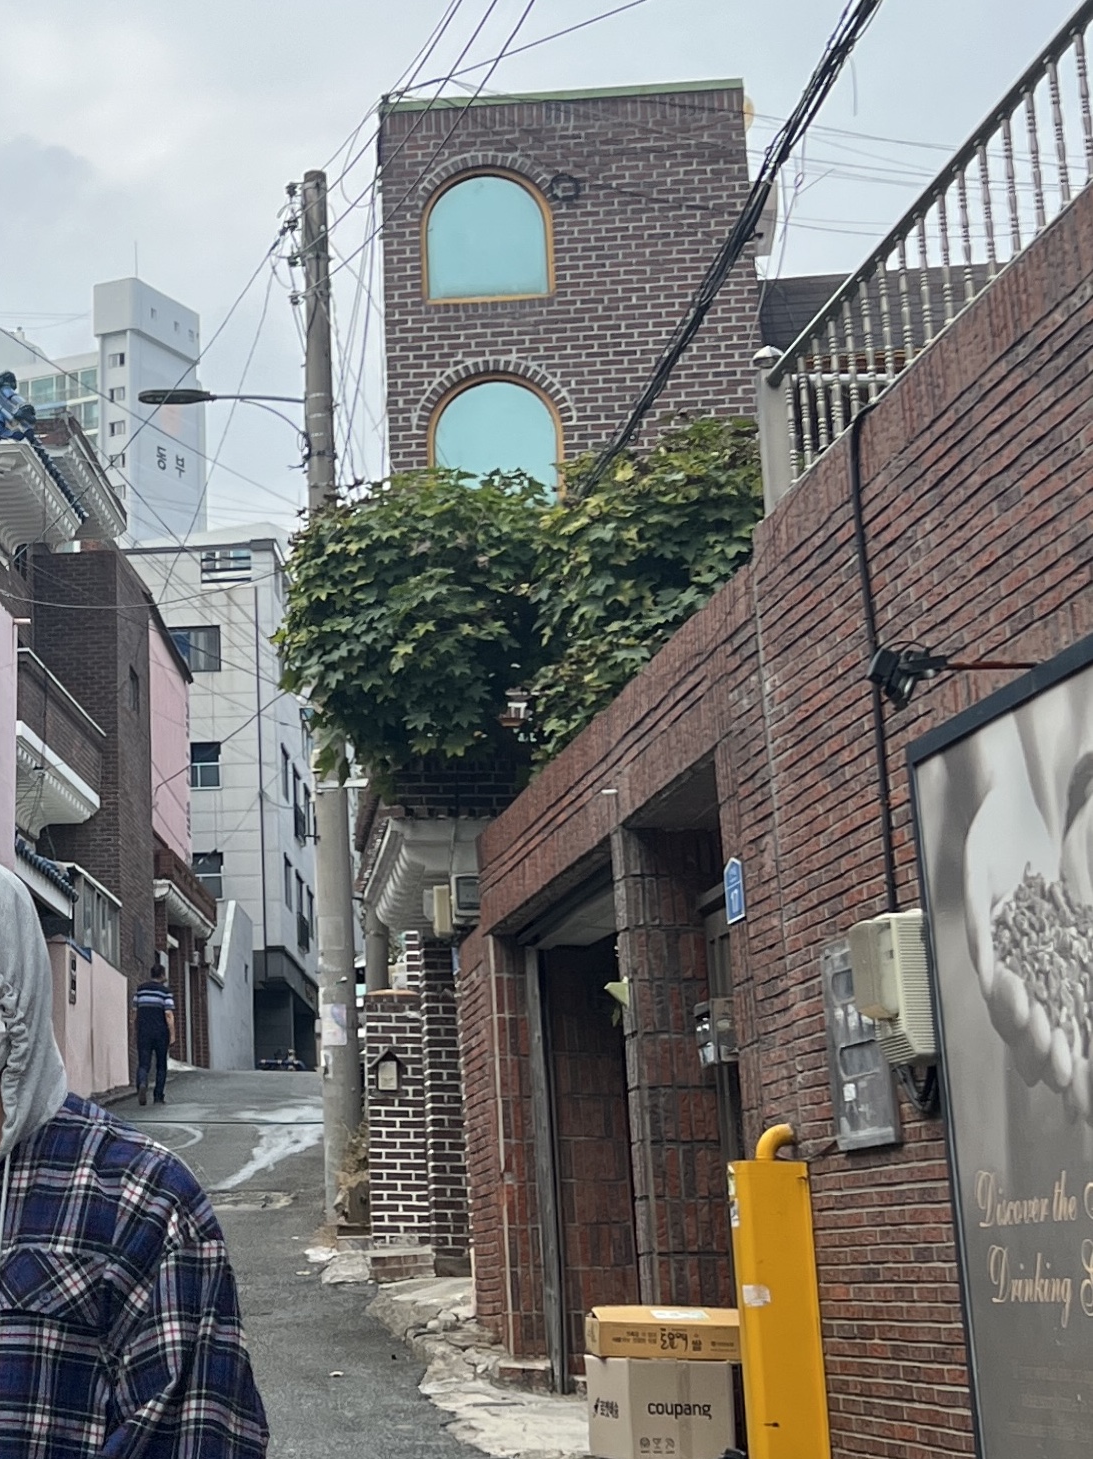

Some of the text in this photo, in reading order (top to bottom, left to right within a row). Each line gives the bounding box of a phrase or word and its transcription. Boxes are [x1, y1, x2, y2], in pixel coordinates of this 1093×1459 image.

[975, 1170, 1049, 1227] Discover
[1052, 1170, 1077, 1221] the
[987, 1244, 1072, 1328] Drinking
[647, 1402, 713, 1420] coupang
